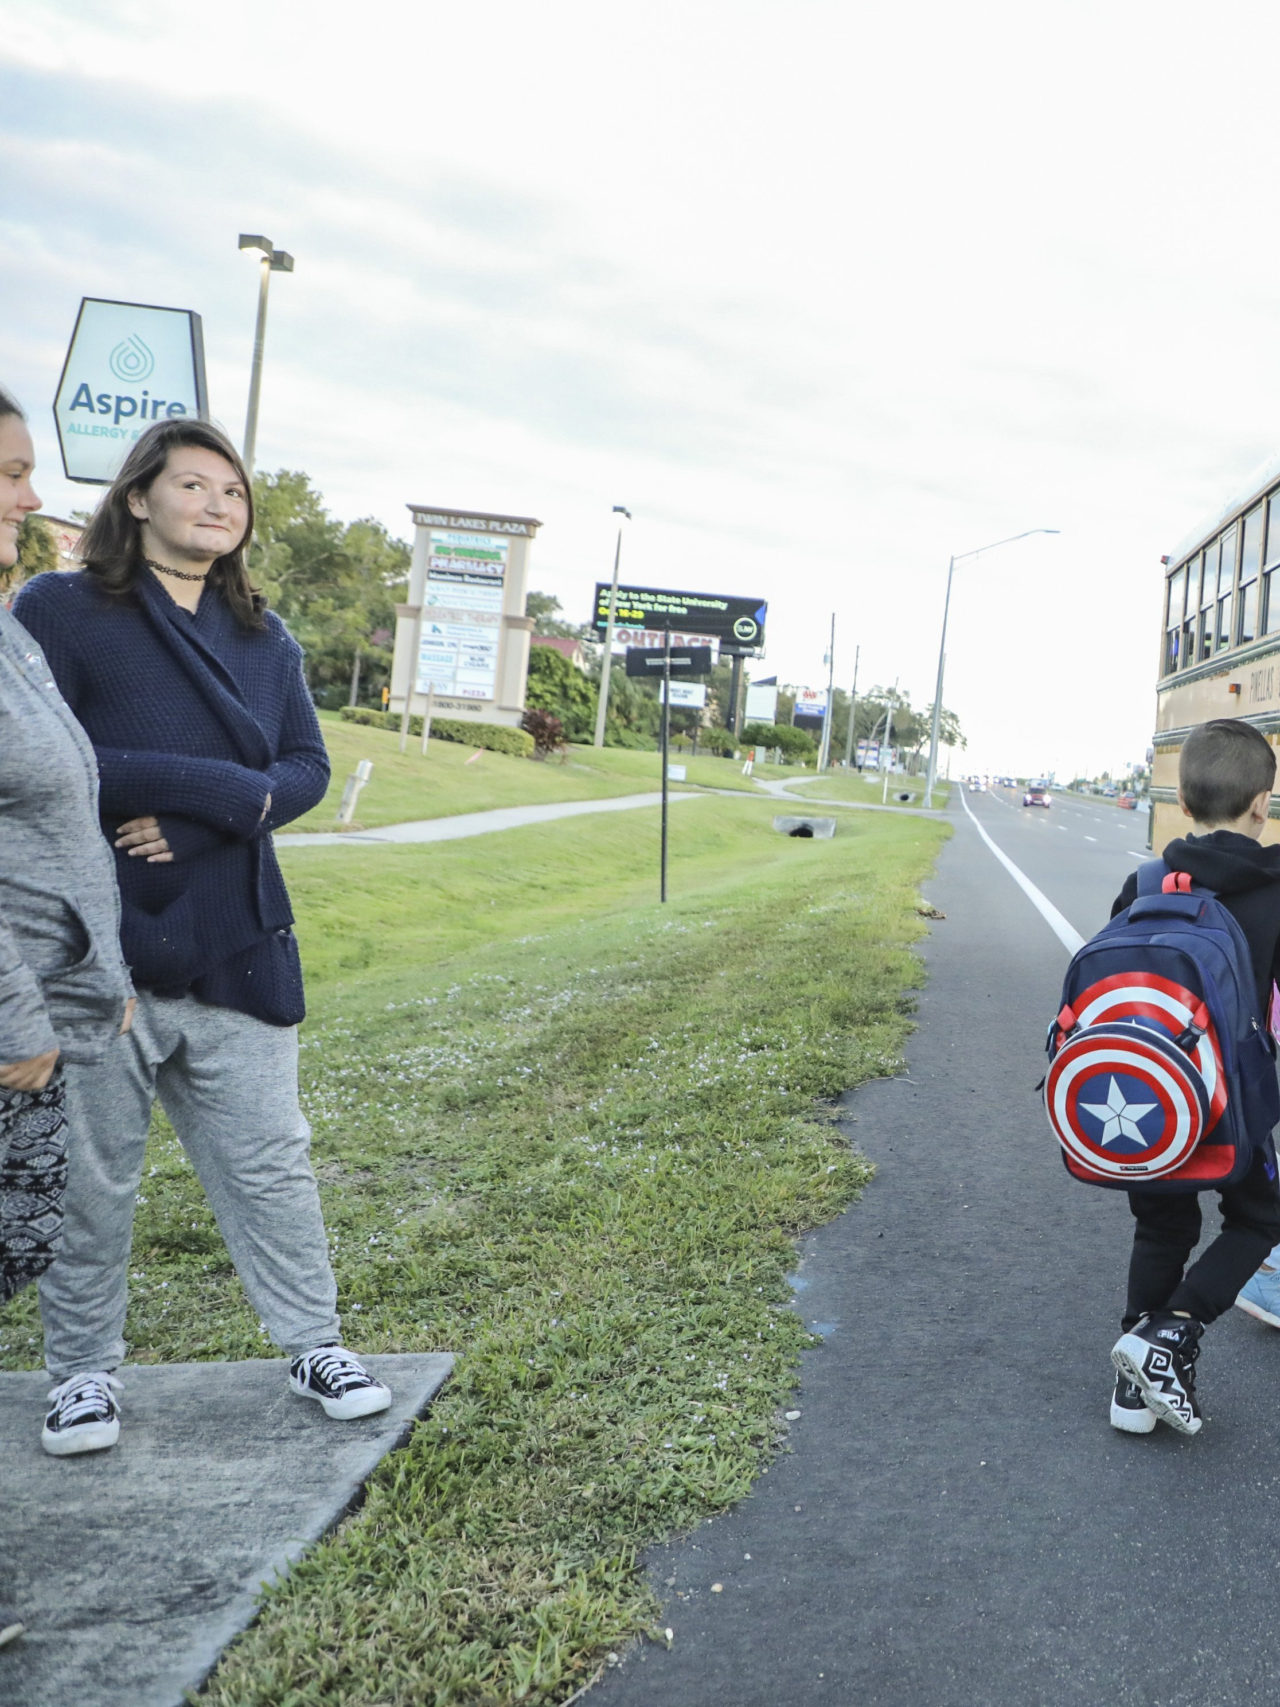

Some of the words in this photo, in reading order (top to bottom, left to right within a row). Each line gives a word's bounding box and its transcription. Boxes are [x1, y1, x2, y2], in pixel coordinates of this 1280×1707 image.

[69, 383, 187, 425] Aspire
[67, 422, 128, 439] ALLERGY
[417, 513, 448, 527] TWIN
[450, 516, 487, 530] LAKES
[489, 521, 528, 535] PLAZA
[431, 558, 505, 575] PHARMACY
[599, 588, 629, 601] Aply
[629, 591, 640, 600] to
[640, 592, 656, 602] the
[656, 594, 681, 604] State
[681, 596, 728, 611] University
[631, 601, 653, 611] York
[653, 603, 668, 612] for
[668, 604, 688, 615] free
[1249, 665, 1275, 704] PINELLAS
